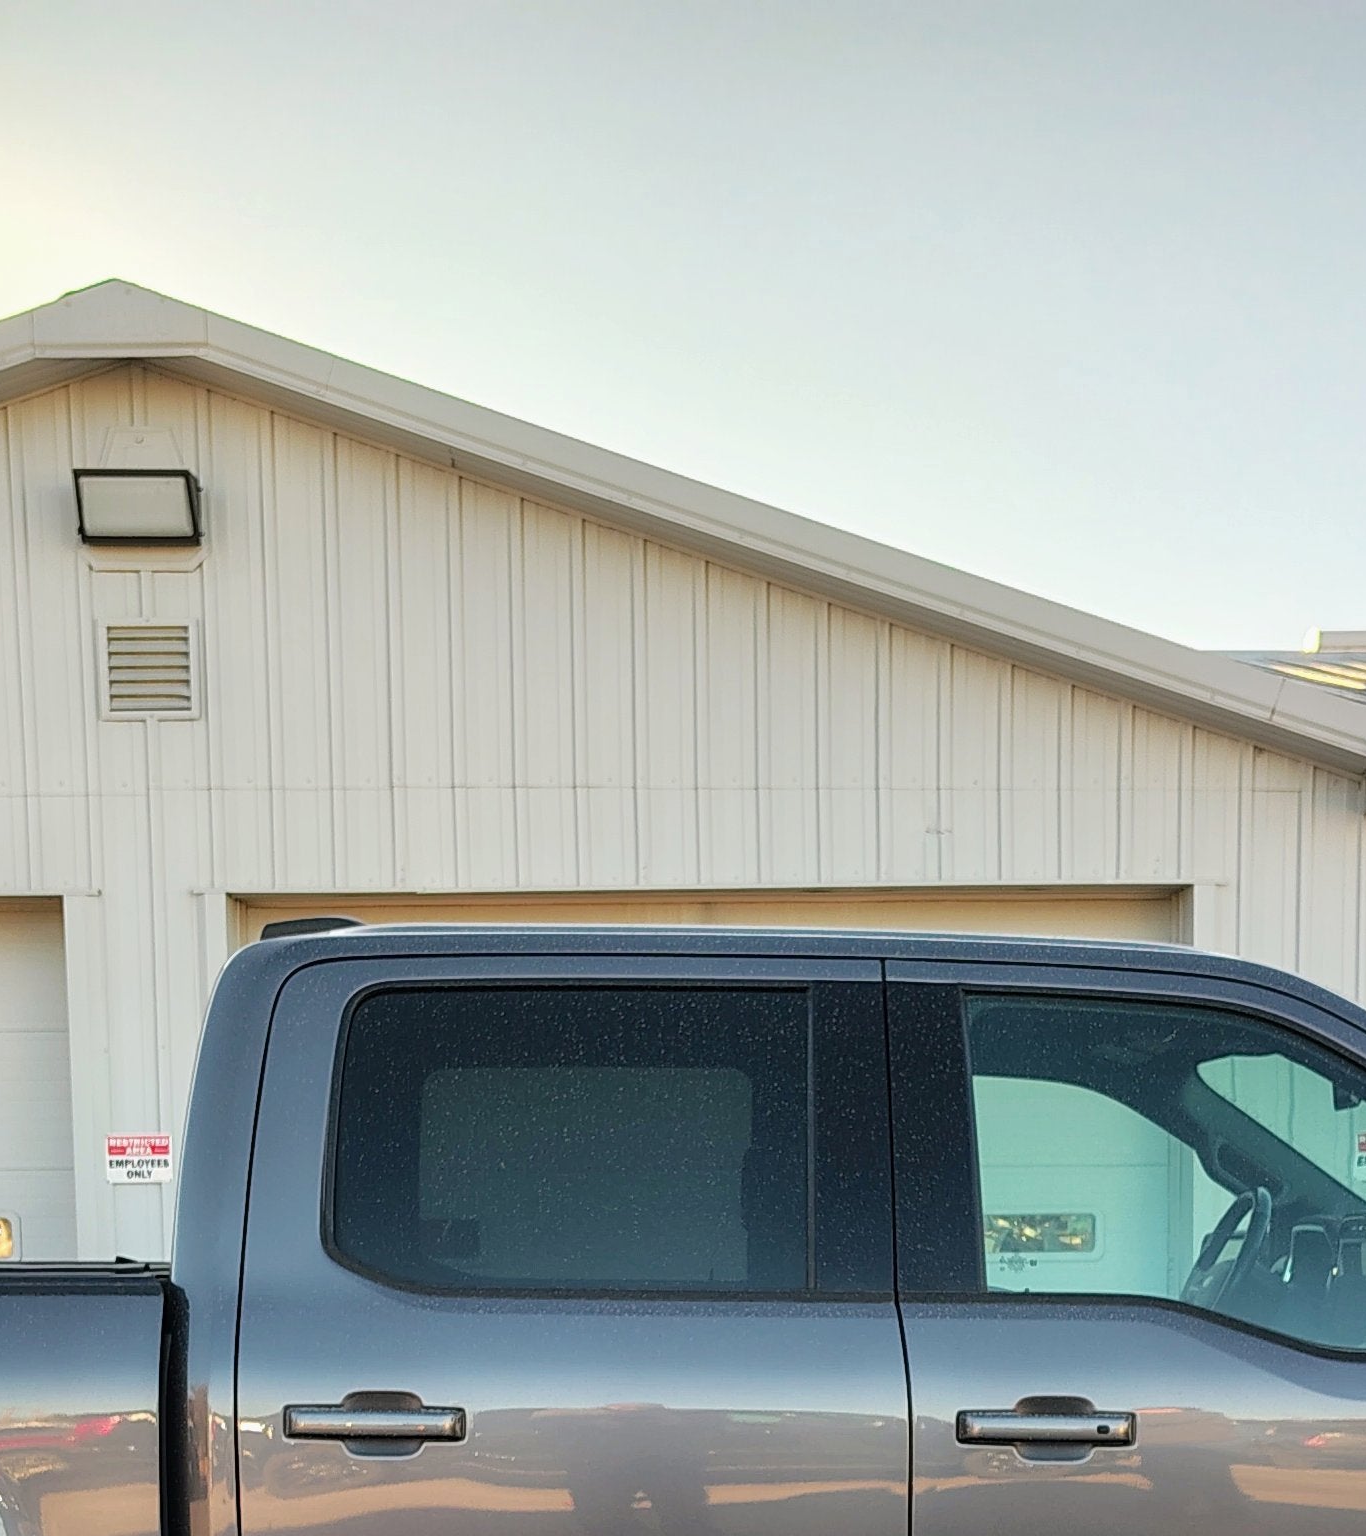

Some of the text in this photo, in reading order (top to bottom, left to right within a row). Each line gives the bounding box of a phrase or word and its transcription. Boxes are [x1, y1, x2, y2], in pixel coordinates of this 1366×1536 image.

[109, 1138, 169, 1147] RESTRICTED
[125, 1146, 152, 1155] AREA
[109, 1159, 169, 1169] EMPLOYEES
[126, 1170, 153, 1179] ONLY
